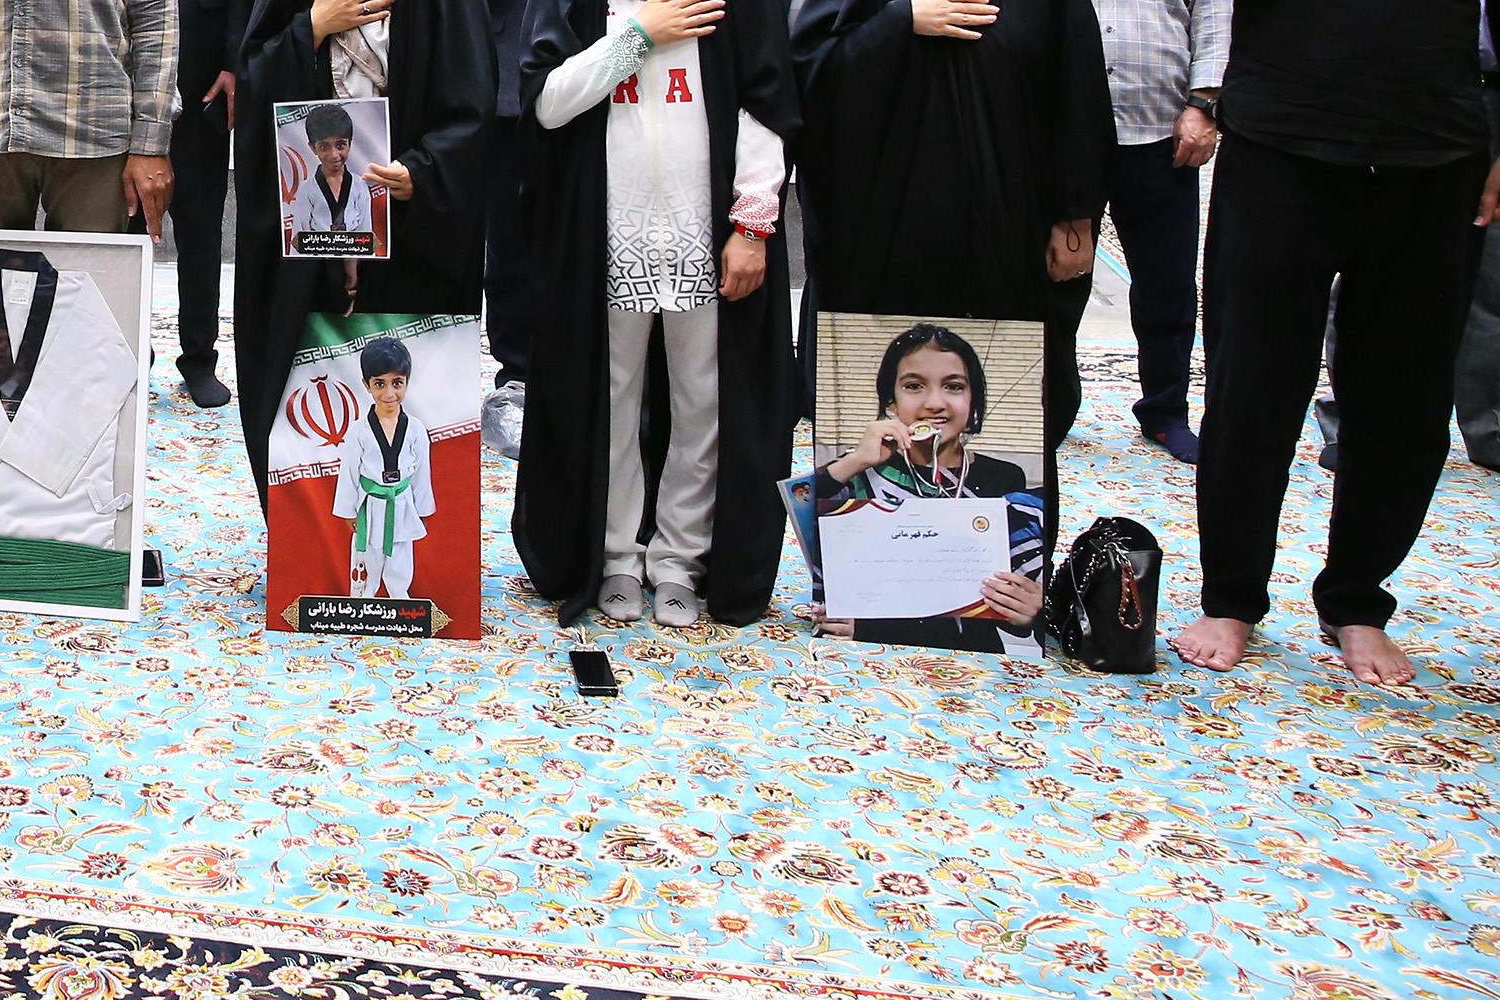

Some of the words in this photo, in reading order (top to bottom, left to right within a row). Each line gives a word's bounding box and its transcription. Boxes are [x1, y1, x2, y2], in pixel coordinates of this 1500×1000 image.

[612, 68, 693, 104] RA
[320, 234, 332, 244] رضا
[332, 234, 355, 245] ورزشکار
[922, 529, 939, 540] حکم
[307, 601, 337, 617] بارانی
[338, 601, 357, 618] رضا
[358, 603, 397, 619] ورزشکار
[398, 606, 426, 619] شهید
[347, 621, 364, 632] شجره
[365, 623, 386, 632] مدرسه
[386, 622, 408, 633] شهادت
[408, 623, 423, 634] محل
